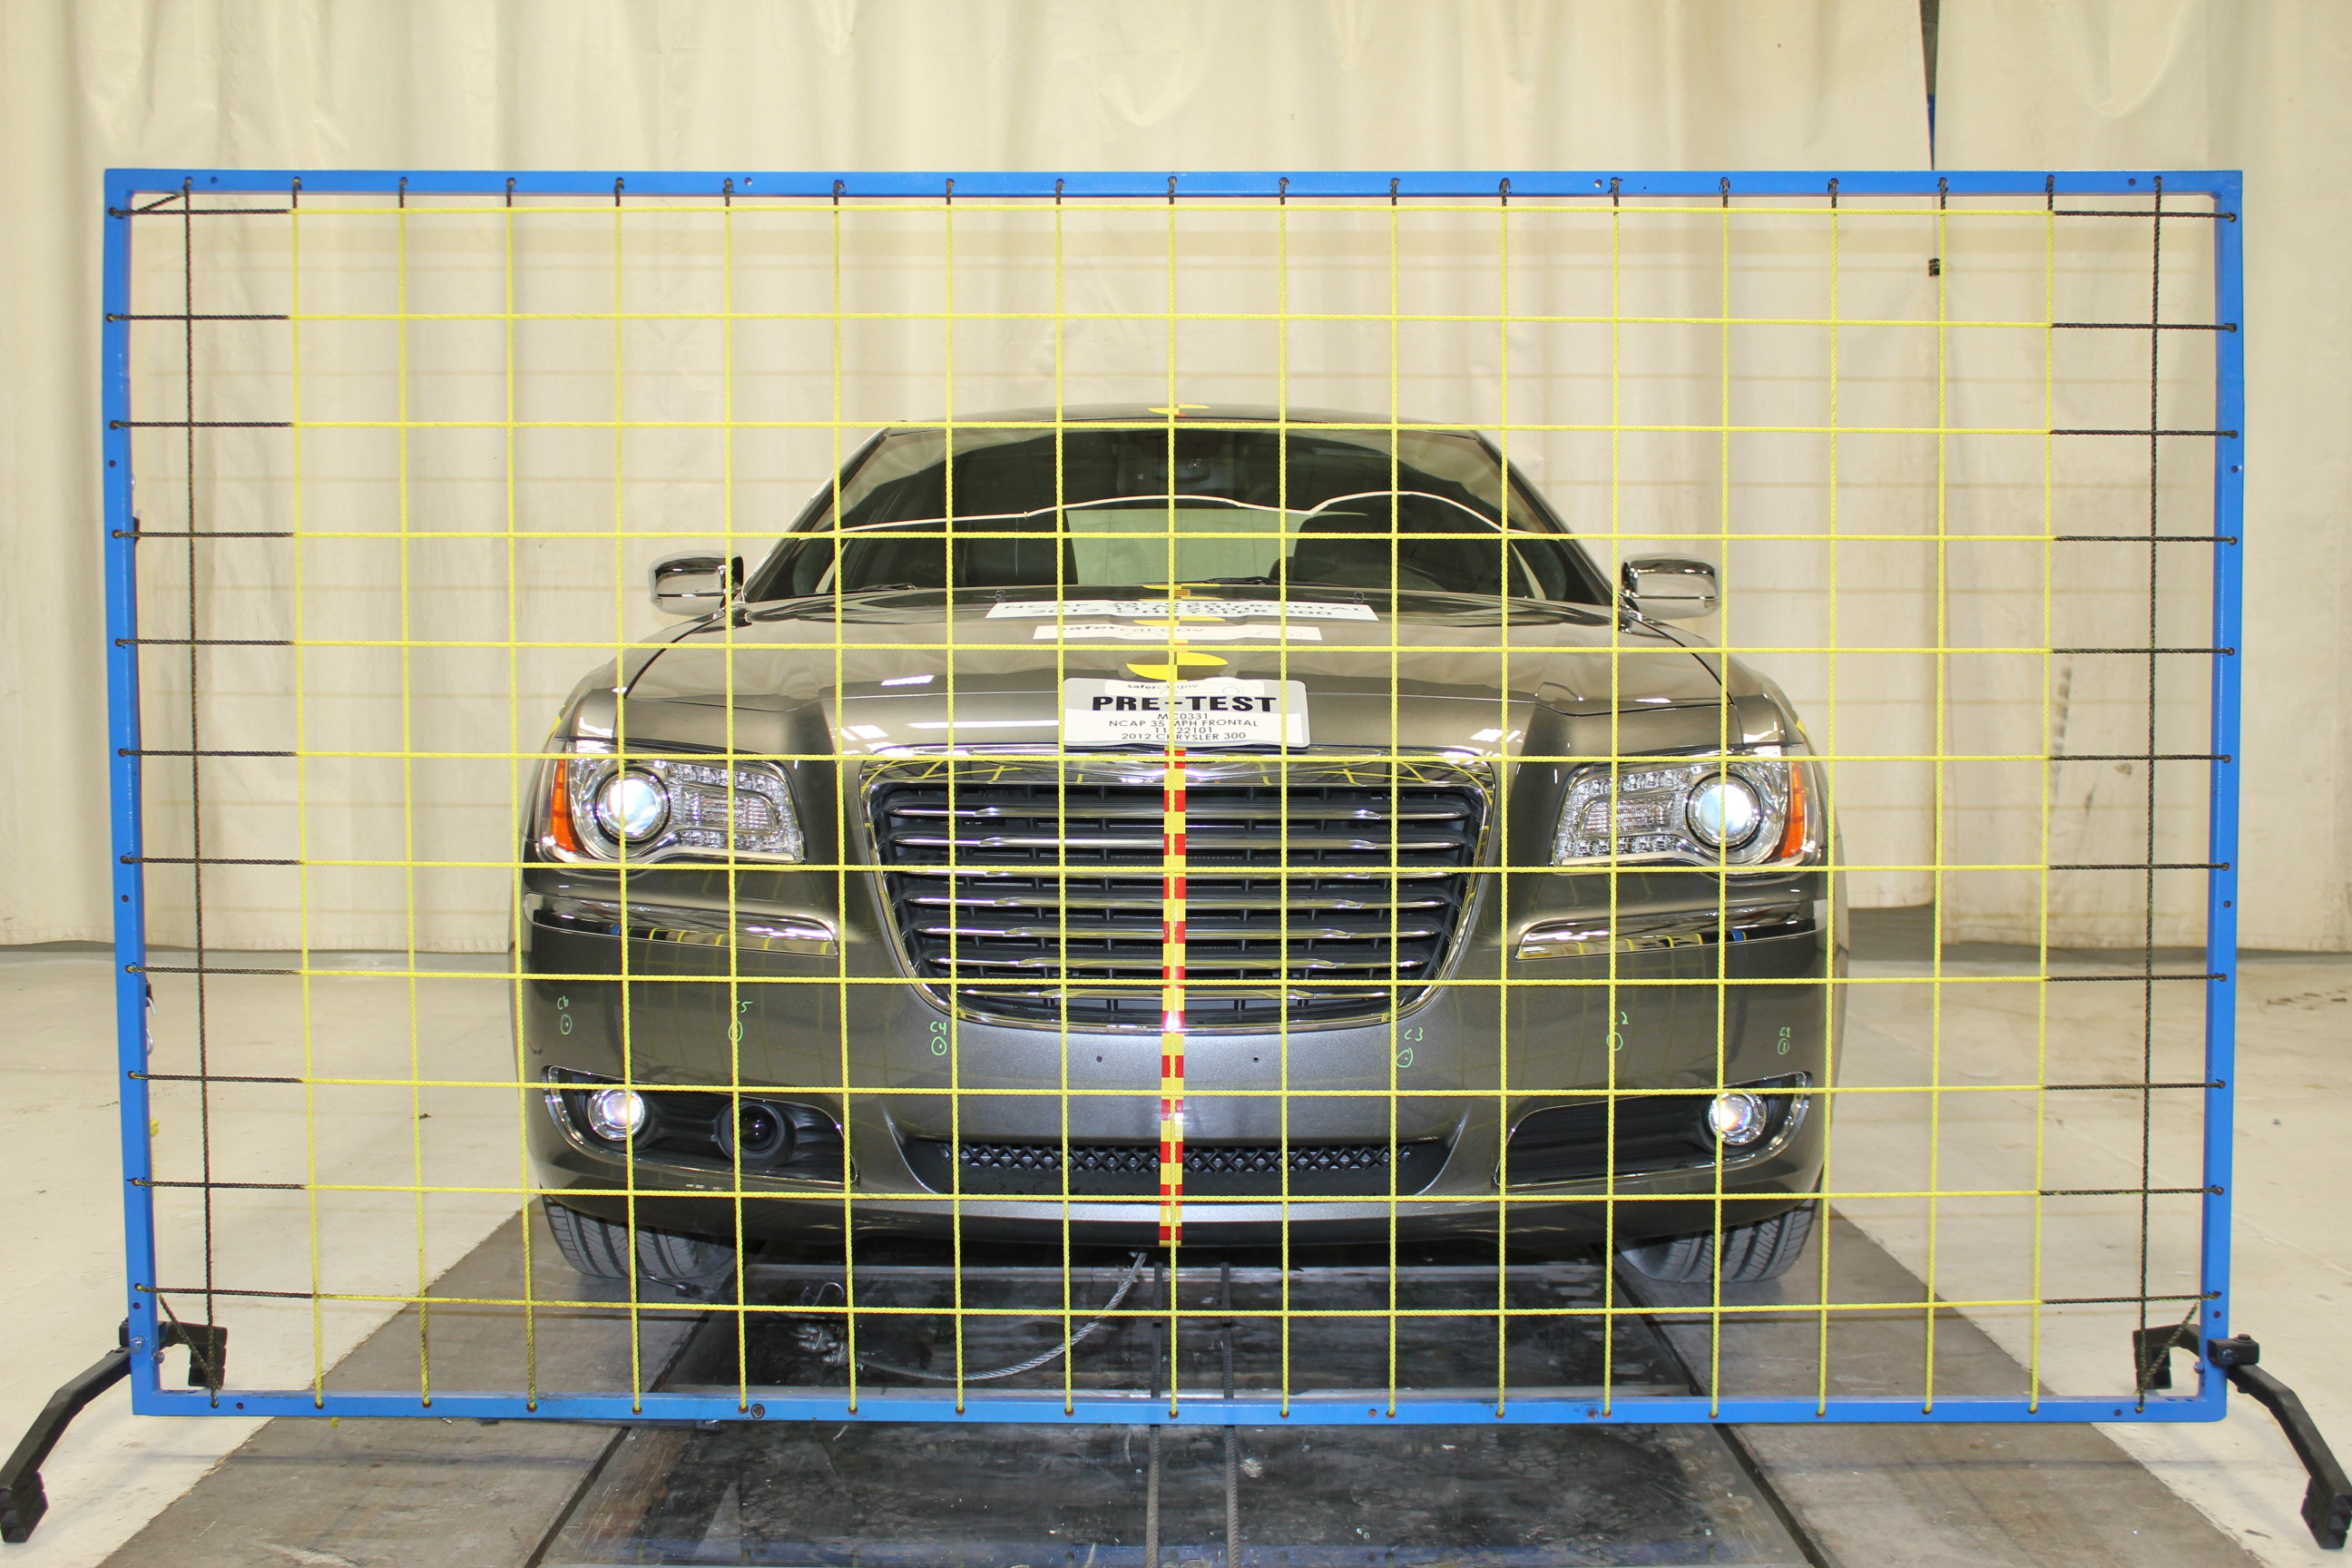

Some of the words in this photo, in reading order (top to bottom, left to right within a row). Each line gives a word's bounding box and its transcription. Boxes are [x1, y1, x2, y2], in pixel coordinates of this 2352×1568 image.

[1092, 696, 1277, 712] PRE-TEST
[1157, 712, 1209, 720] MC0331
[1202, 719, 1259, 727] FRONTAL
[1223, 731, 1247, 740] 300
[929, 1021, 948, 1036] C4
[1403, 1026, 1424, 1043] C3
